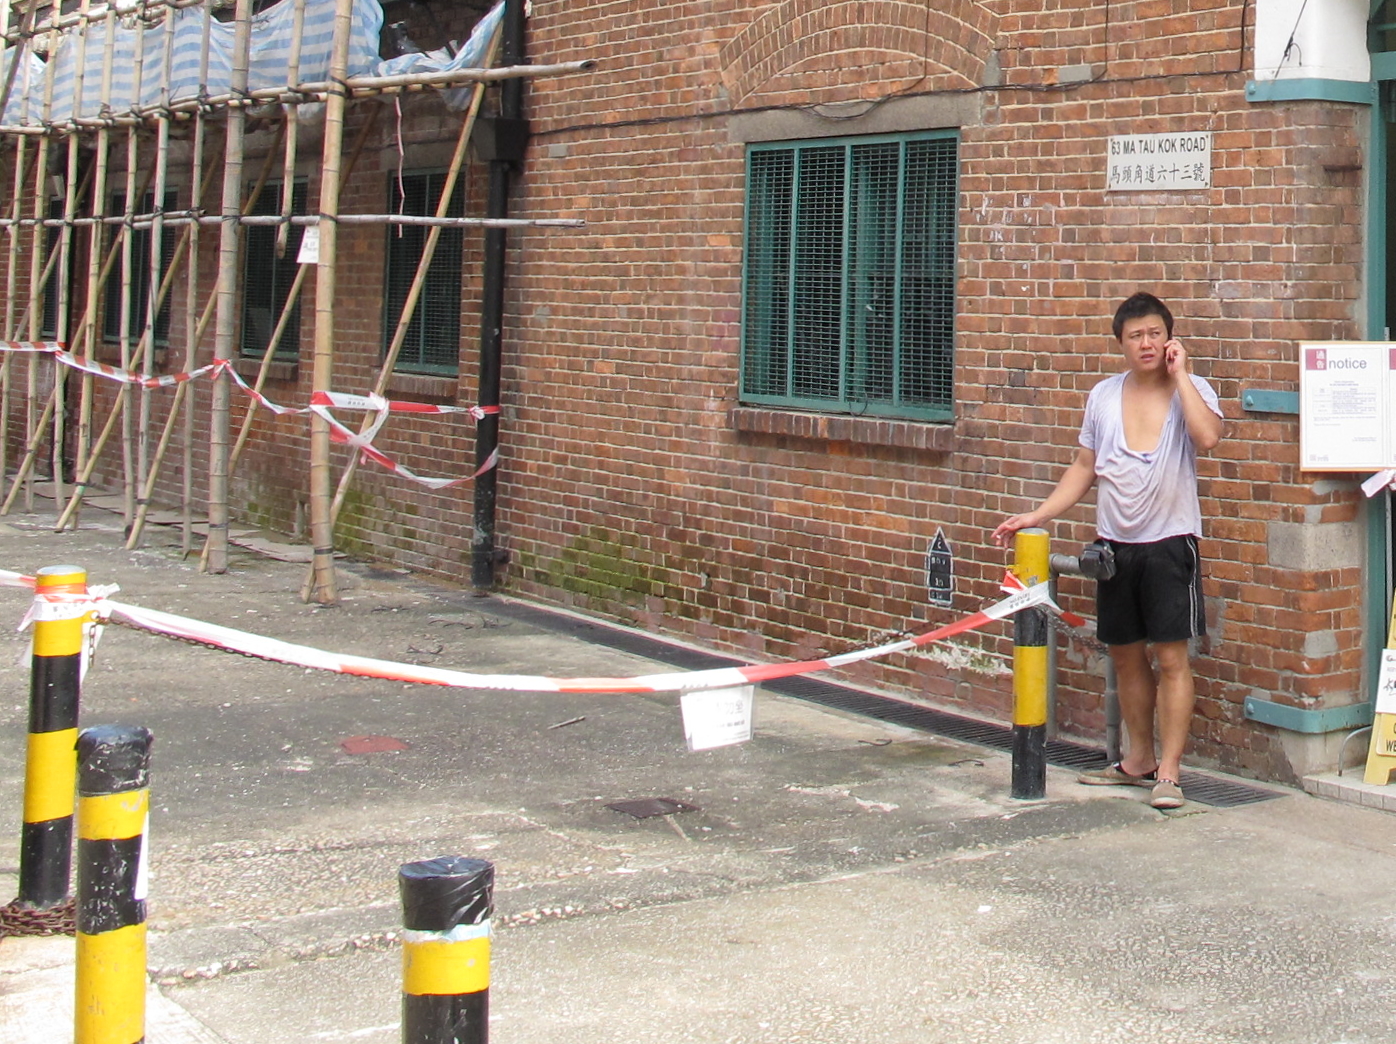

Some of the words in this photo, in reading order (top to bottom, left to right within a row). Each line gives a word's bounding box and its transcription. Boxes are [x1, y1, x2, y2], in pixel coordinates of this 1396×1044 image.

[1111, 141, 1121, 155] 63
[1123, 140, 1136, 154] MA
[1139, 139, 1156, 154] TAU
[1158, 138, 1177, 153] KOK
[1180, 137, 1206, 152] ROAD
[1110, 162, 1206, 184] 馬頭角道六十三號
[1329, 357, 1367, 369] notice
